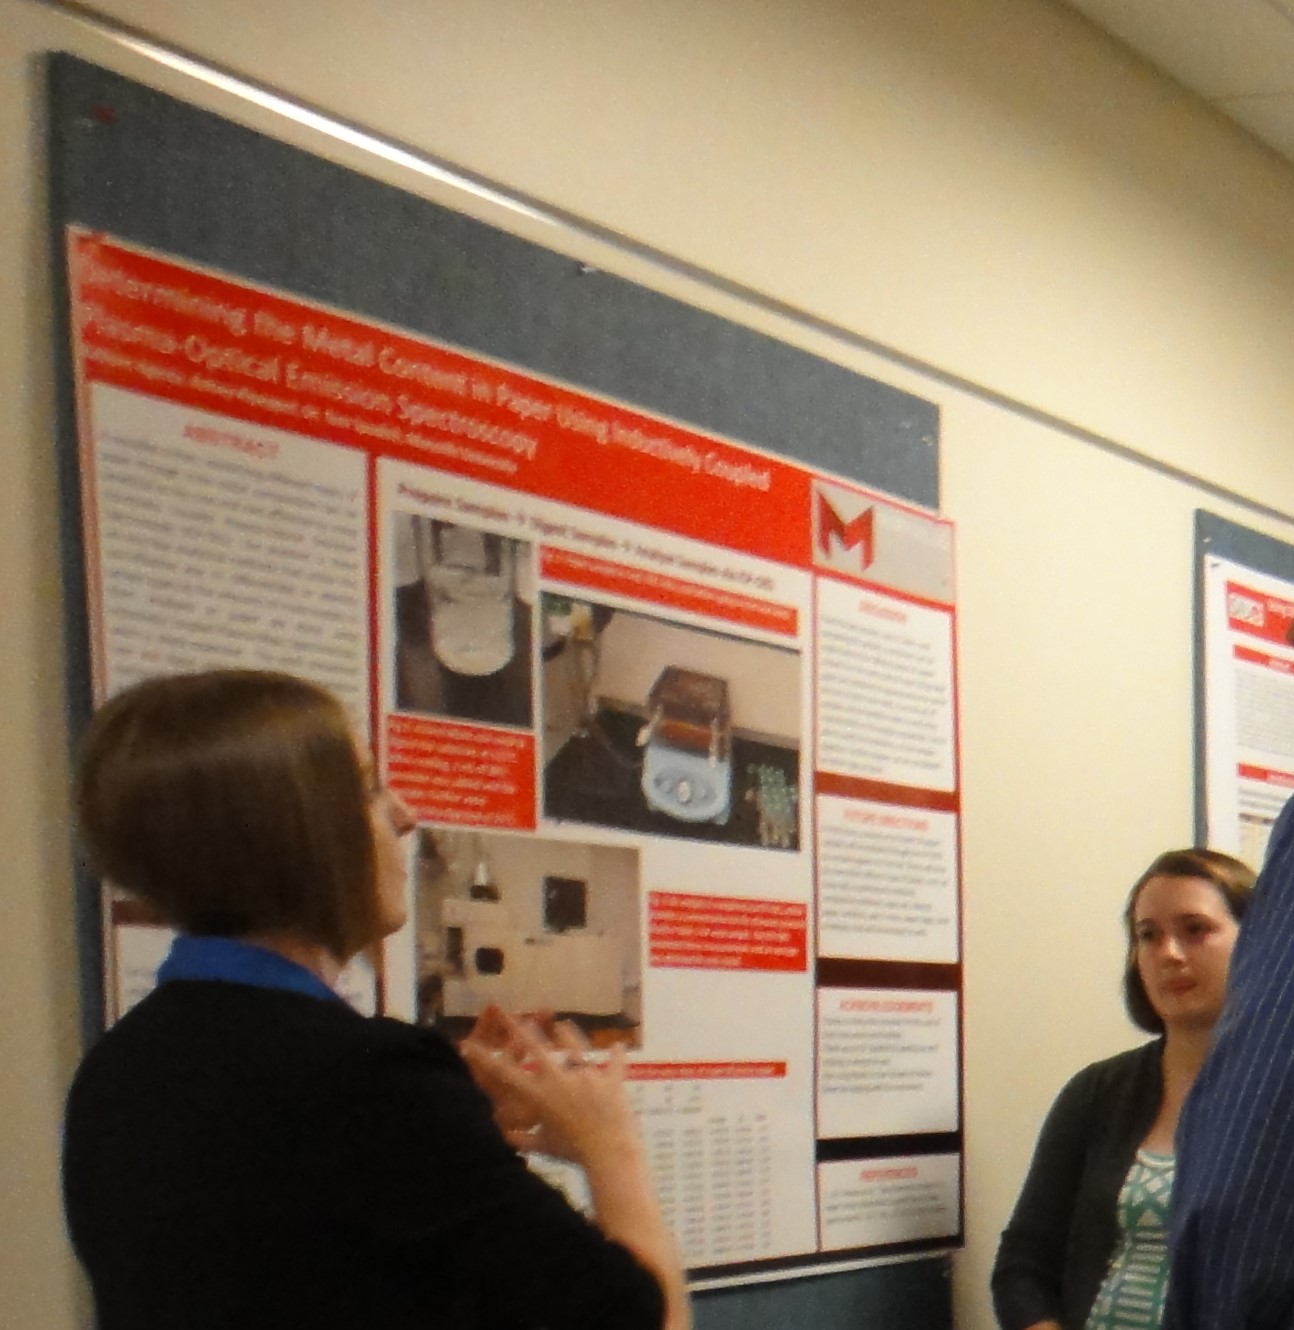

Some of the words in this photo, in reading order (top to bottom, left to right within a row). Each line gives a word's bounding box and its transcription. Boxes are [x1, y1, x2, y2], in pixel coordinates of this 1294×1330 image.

[253, 309, 296, 345] the
[302, 323, 376, 368] Metal
[379, 347, 466, 398] Content
[470, 373, 491, 402] in
[705, 444, 771, 492] Coupled
[285, 363, 394, 416] Emission
[397, 394, 538, 461] Spectroscopy
